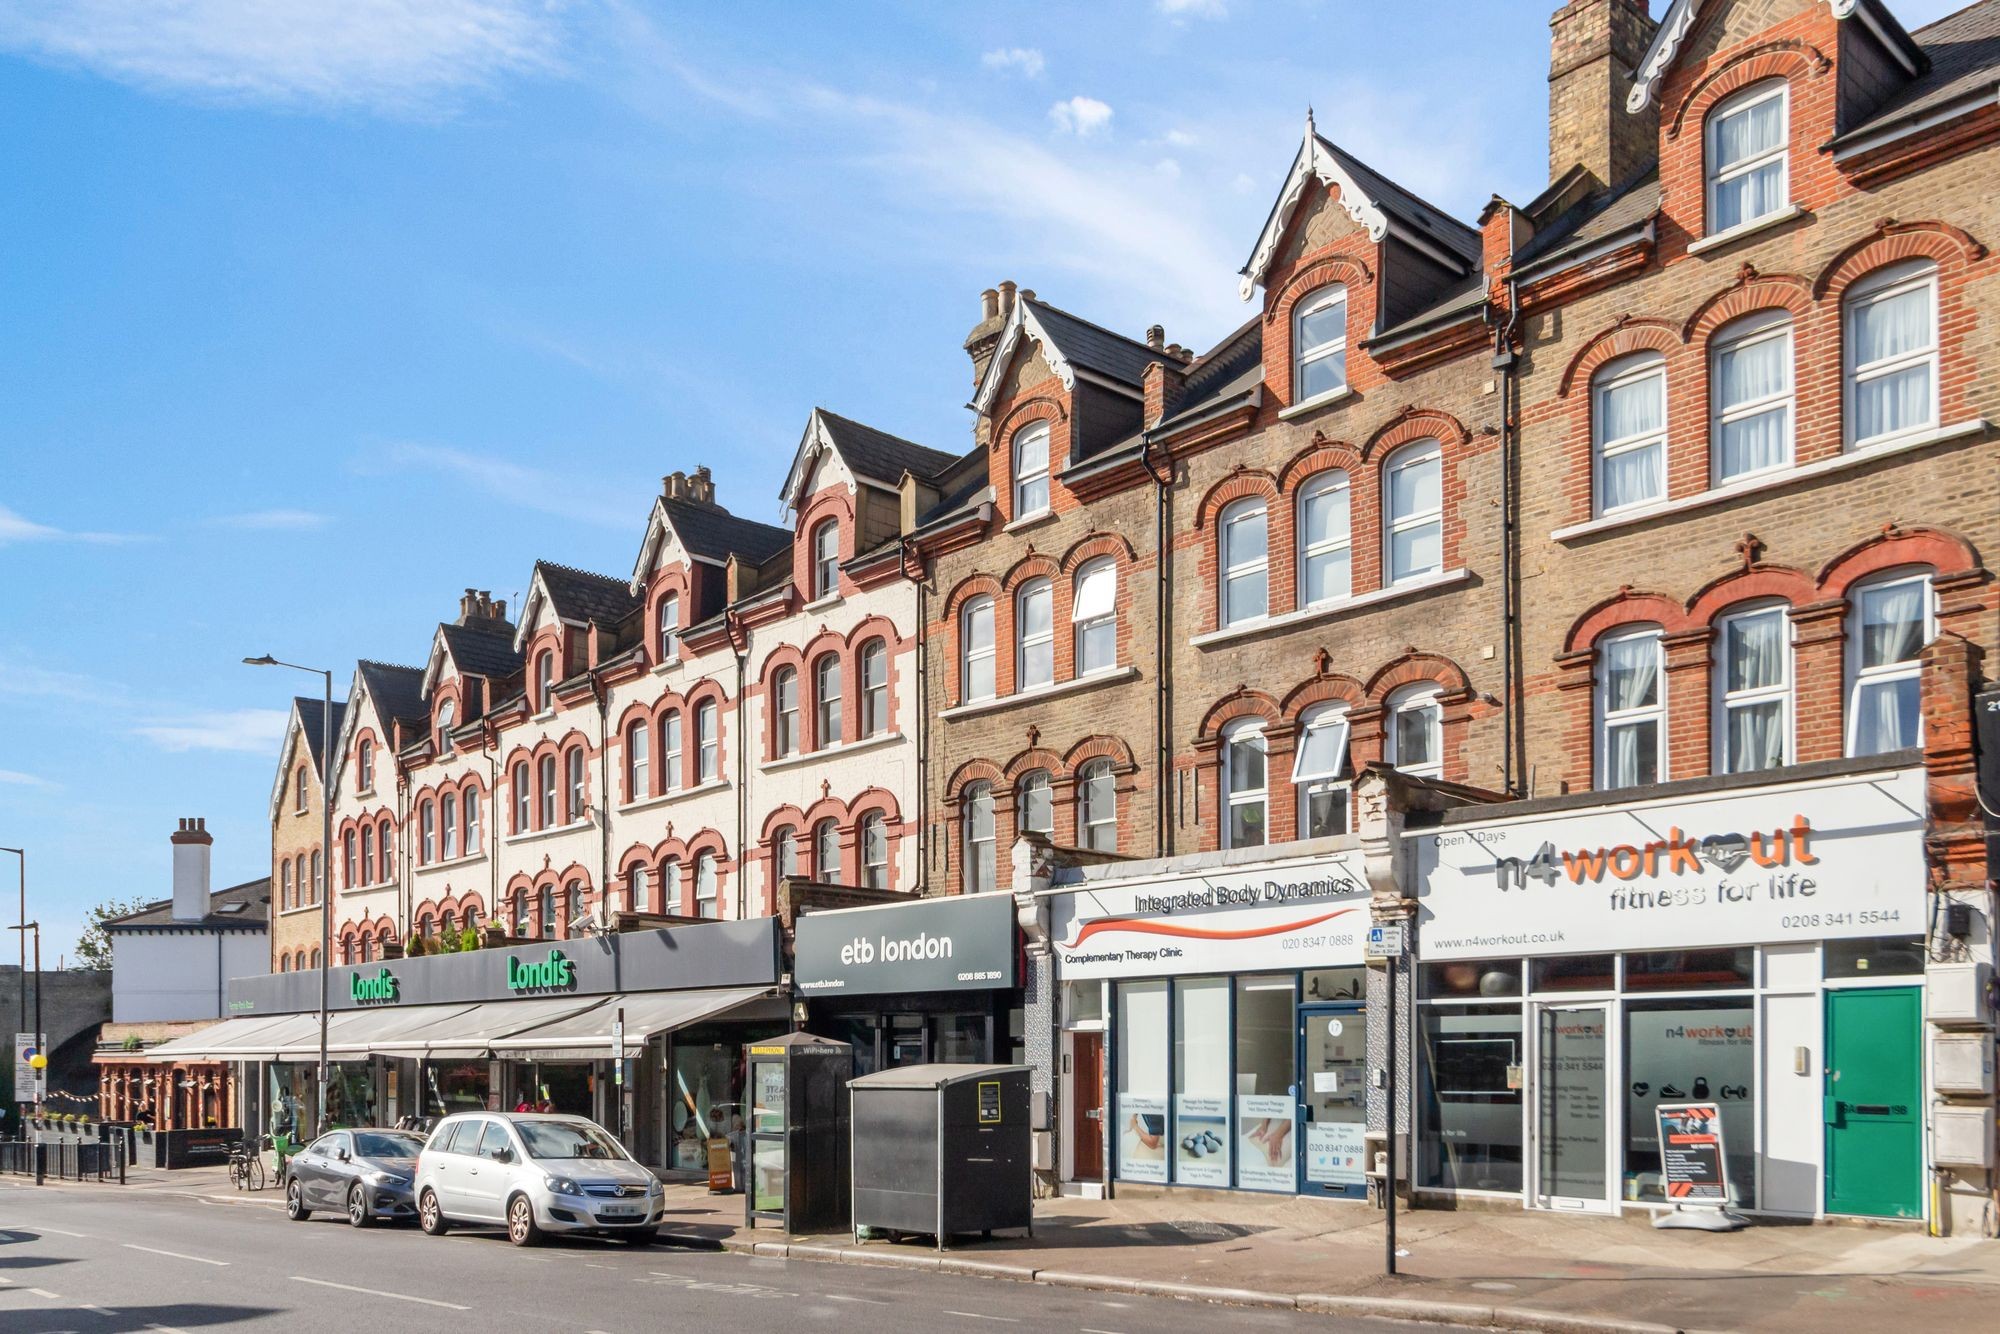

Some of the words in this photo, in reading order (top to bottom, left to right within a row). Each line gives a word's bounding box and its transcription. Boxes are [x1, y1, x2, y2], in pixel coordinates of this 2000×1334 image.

[1434, 836, 1464, 848] Open
[1468, 832, 1474, 843] 7
[1478, 831, 1506, 844] Days
[1135, 888, 1213, 914] Integrated
[1216, 883, 1261, 906] Body
[1265, 875, 1354, 903] Dynamics
[1611, 884, 1706, 910] fitness
[1718, 878, 1759, 904] for
[1769, 873, 1817, 900] life
[1782, 915, 1819, 928] 0208
[1825, 912, 1852, 926] 341
[1860, 909, 1900, 924] 5544
[841, 937, 874, 965] etb
[880, 932, 952, 962] london
[1282, 938, 1300, 949] 020
[1303, 936, 1326, 948] 8347
[1329, 935, 1353, 946] 0888
[1434, 929, 1565, 949] www.n4workout.co.uk
[1065, 951, 1123, 965] Complementary
[1125, 949, 1158, 960] Therapy
[1160, 947, 1182, 958] Clinic
[507, 949, 573, 991] Londis
[351, 967, 396, 1000] Londis
[1309, 1143, 1324, 1151] 020
